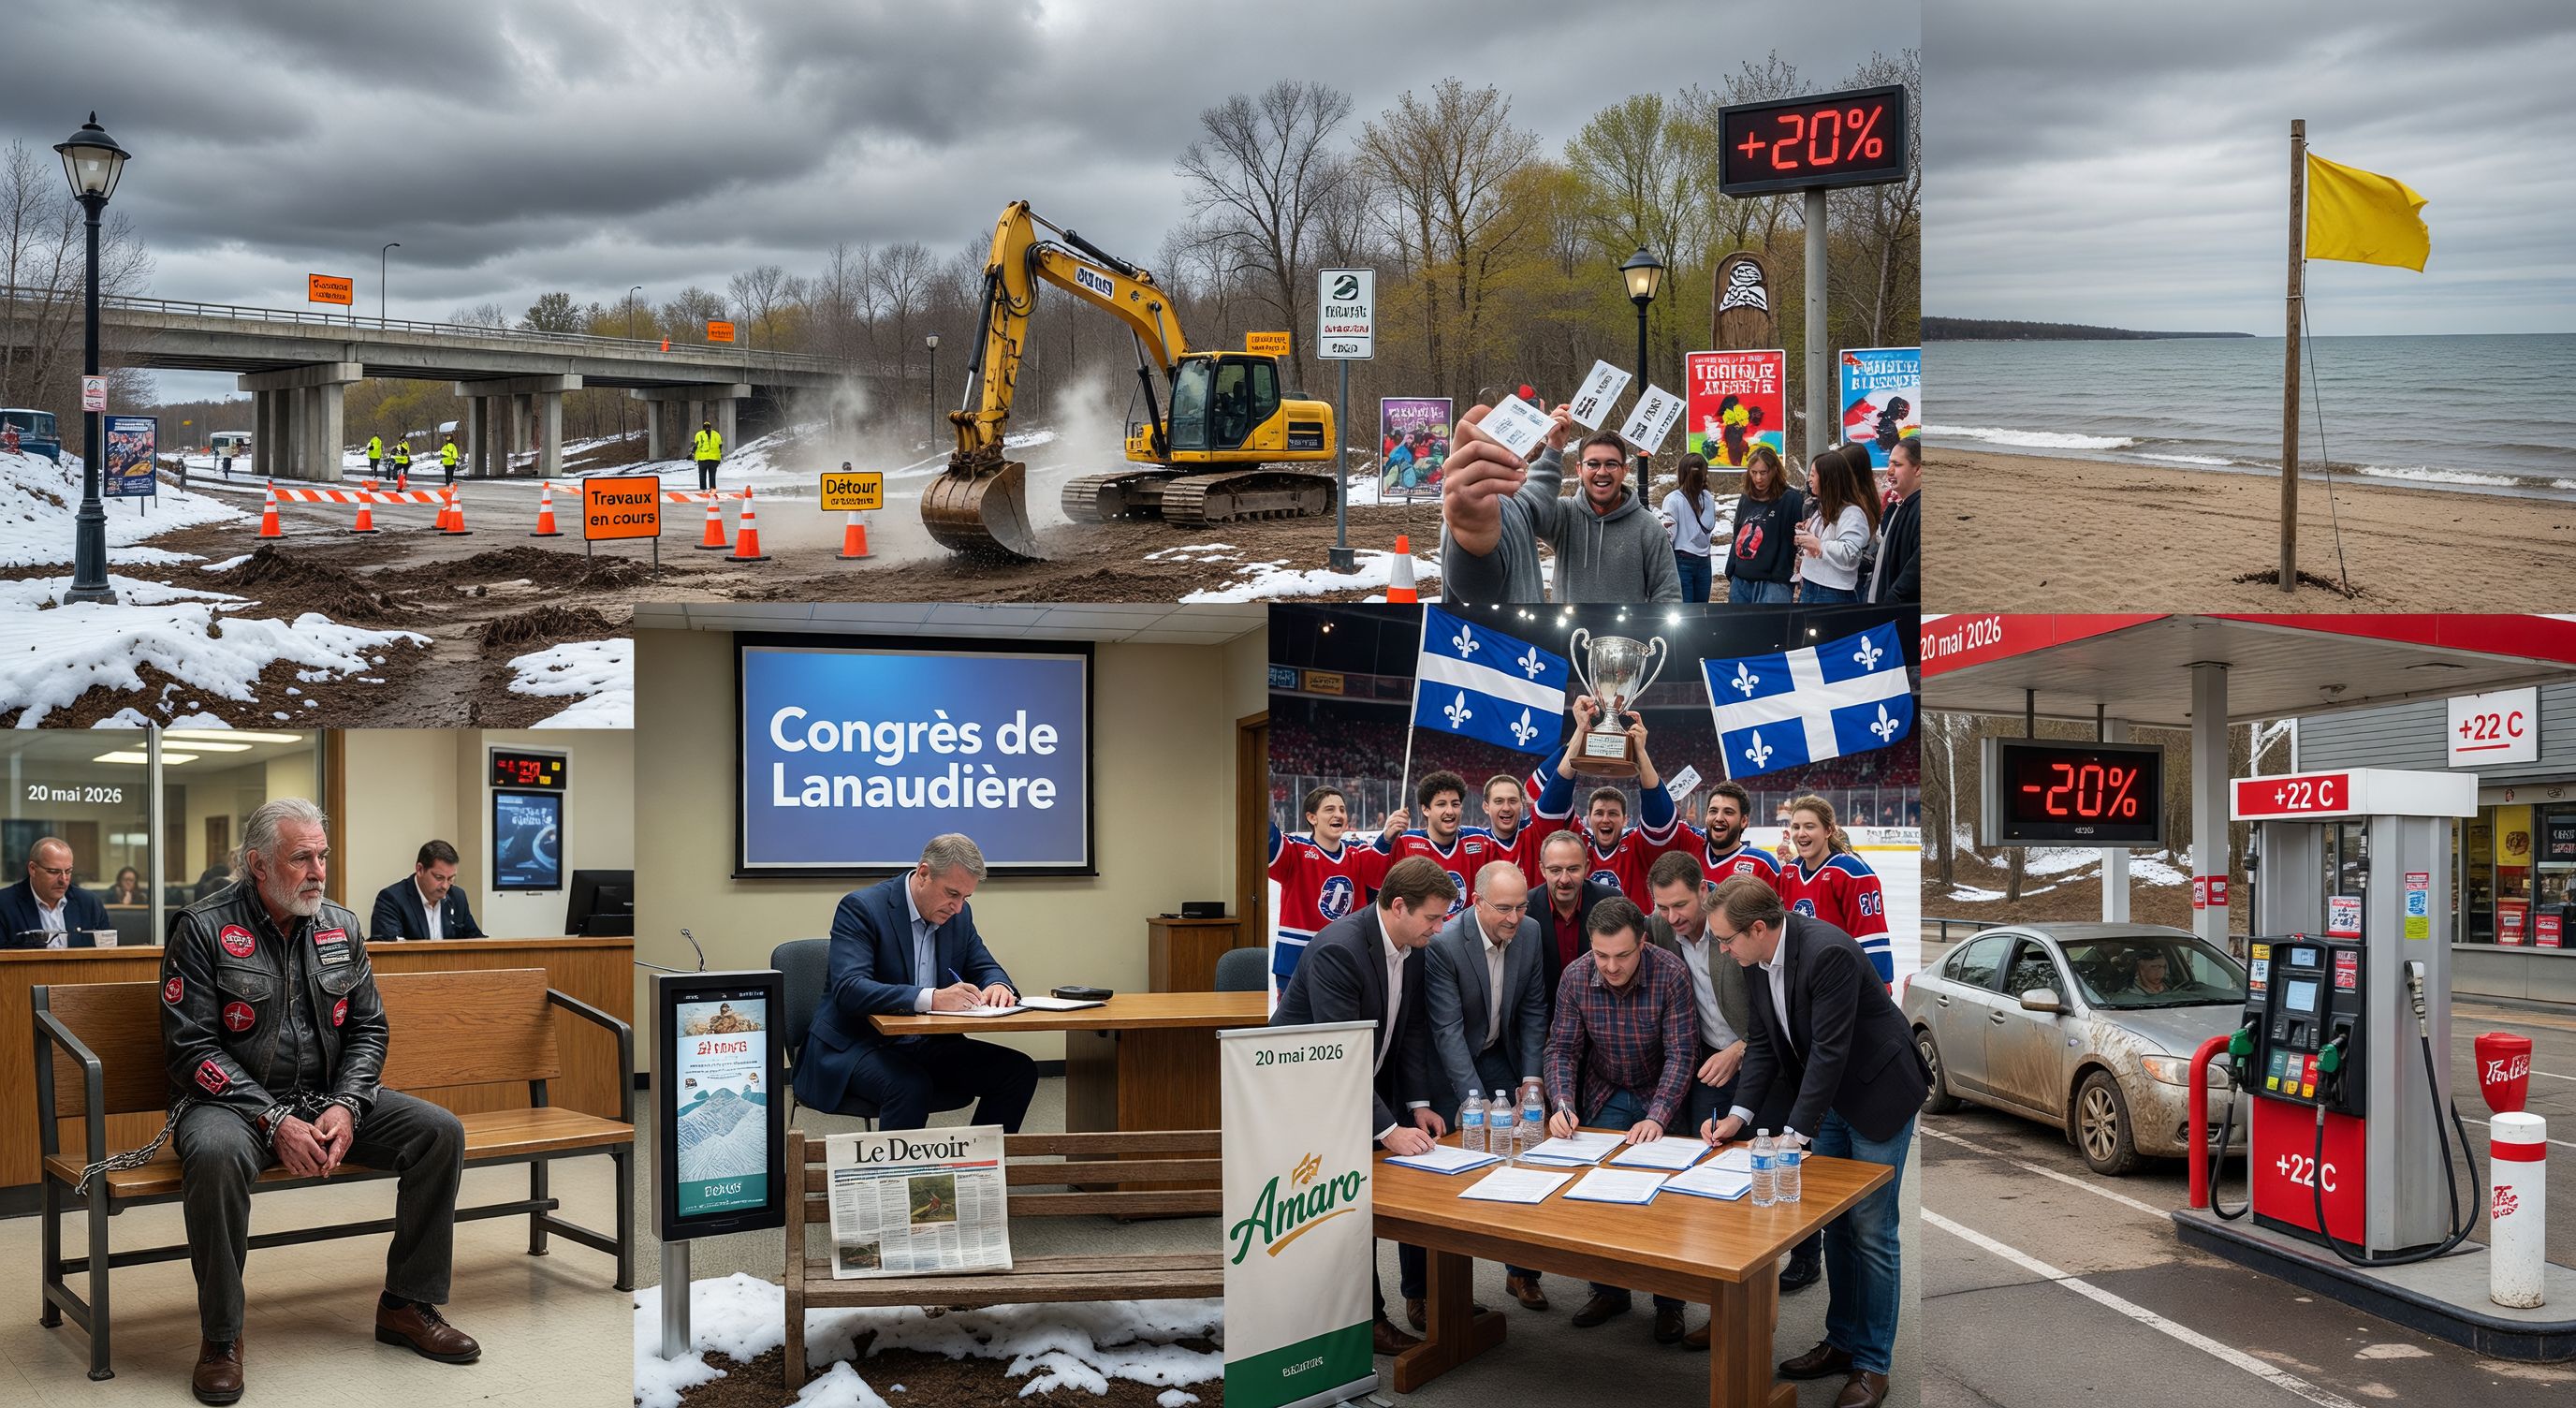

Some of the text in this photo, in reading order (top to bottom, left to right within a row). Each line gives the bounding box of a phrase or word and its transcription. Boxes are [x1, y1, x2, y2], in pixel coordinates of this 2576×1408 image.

[1737, 105, 1883, 169] +20%
[592, 491, 651, 506] Travaux
[826, 478, 878, 495] Détour
[591, 512, 656, 525] en cours
[1920, 616, 2002, 661] 20 mai 2026
[769, 706, 1059, 766] Congrès de
[2459, 711, 2525, 741] +22 C
[28, 785, 123, 803] 20 mai 2026
[773, 762, 1057, 810] Lanaudière
[2022, 763, 2137, 817] -20%
[2274, 780, 2334, 809] +22 C
[1255, 1043, 1343, 1066] 20 mai 2026
[854, 1136, 970, 1164] Le Devoir
